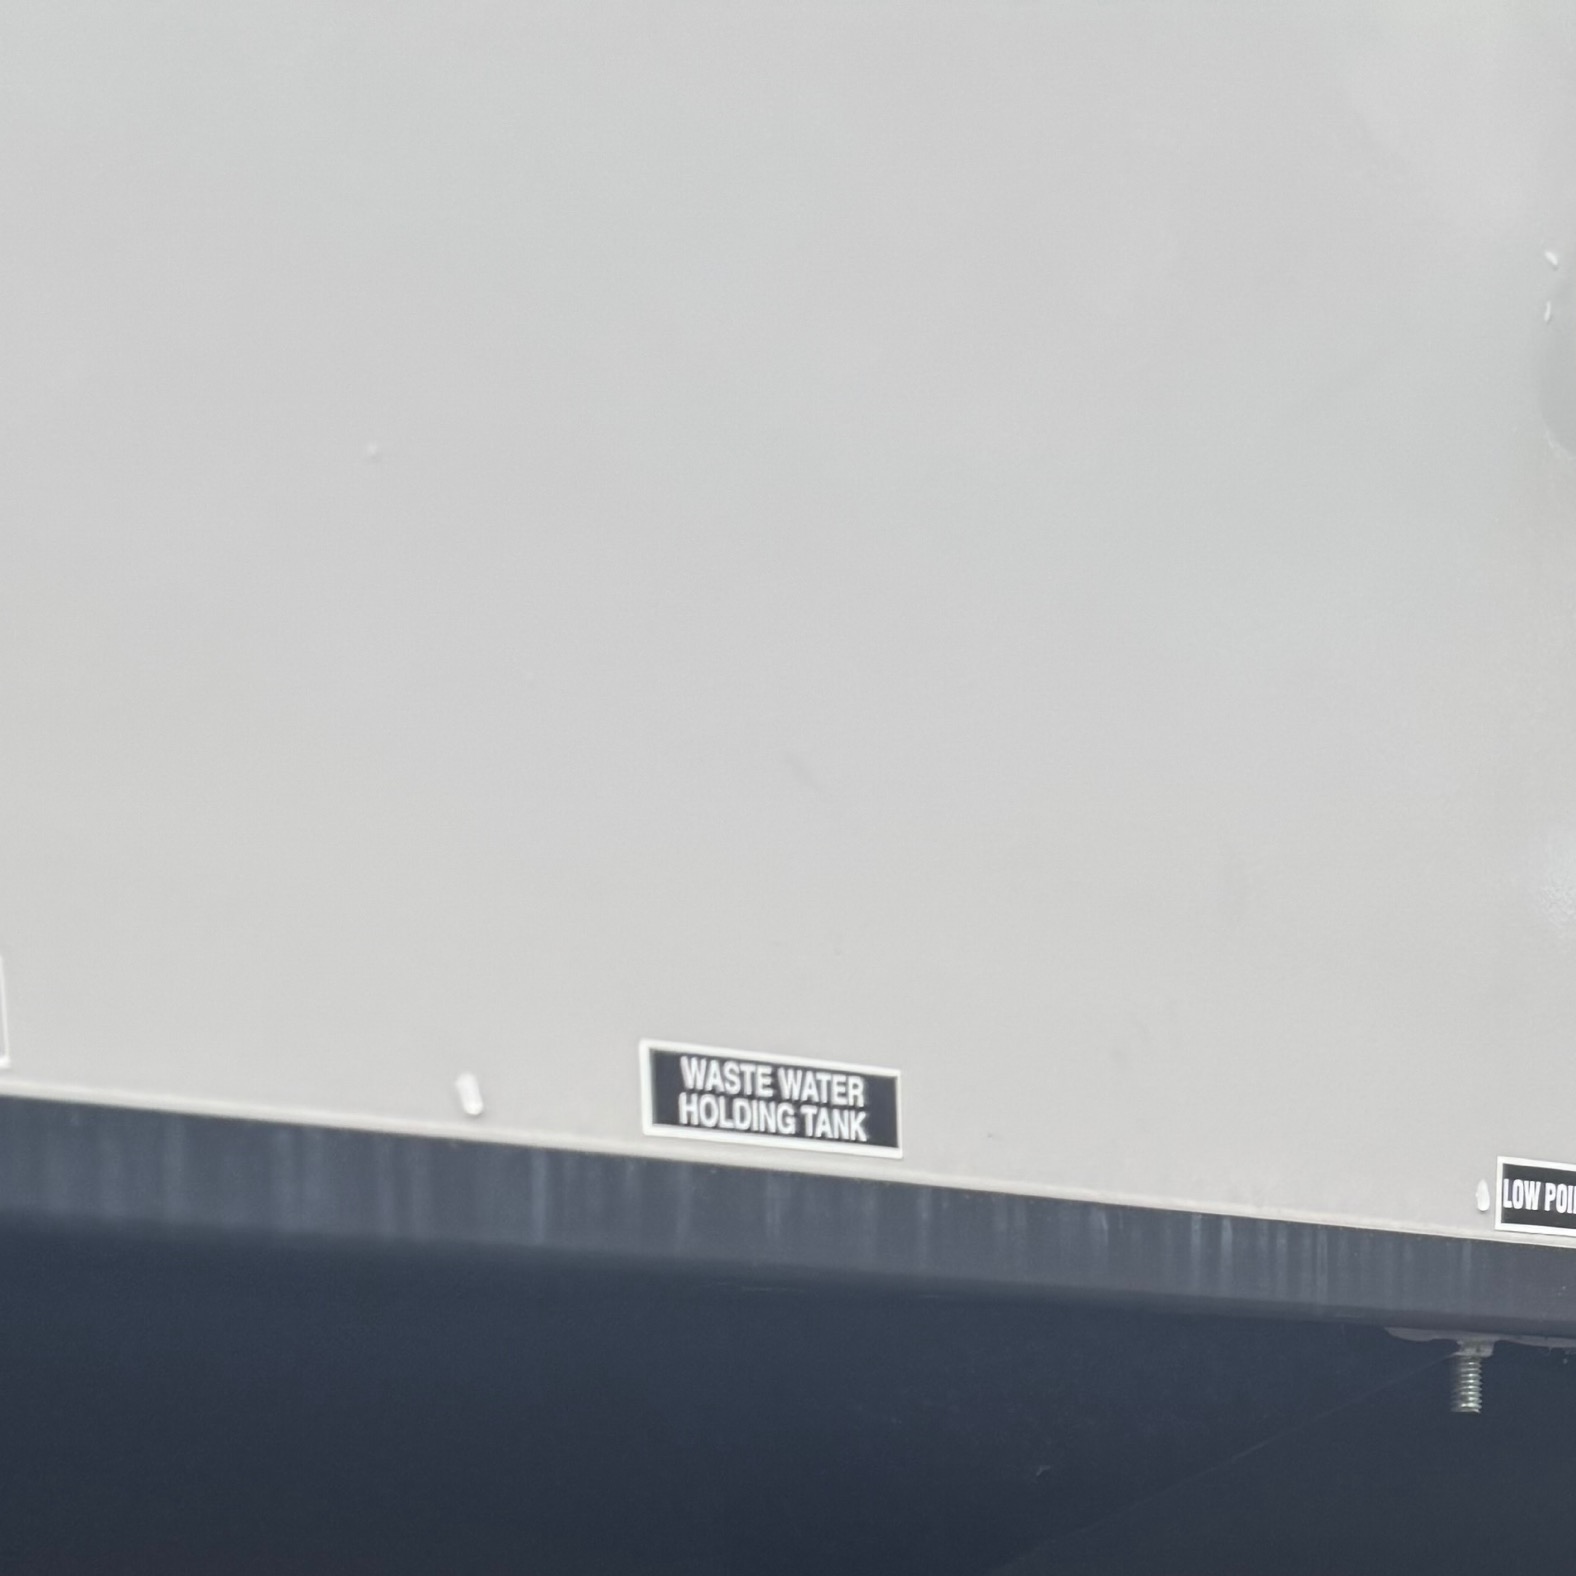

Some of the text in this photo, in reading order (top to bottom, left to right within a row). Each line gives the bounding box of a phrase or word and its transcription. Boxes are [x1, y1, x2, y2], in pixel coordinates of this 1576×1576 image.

[680, 1056, 865, 1108] WASTE WATER
[679, 1092, 867, 1142] HOLDING TANK
[1503, 1178, 1542, 1210] LOW
